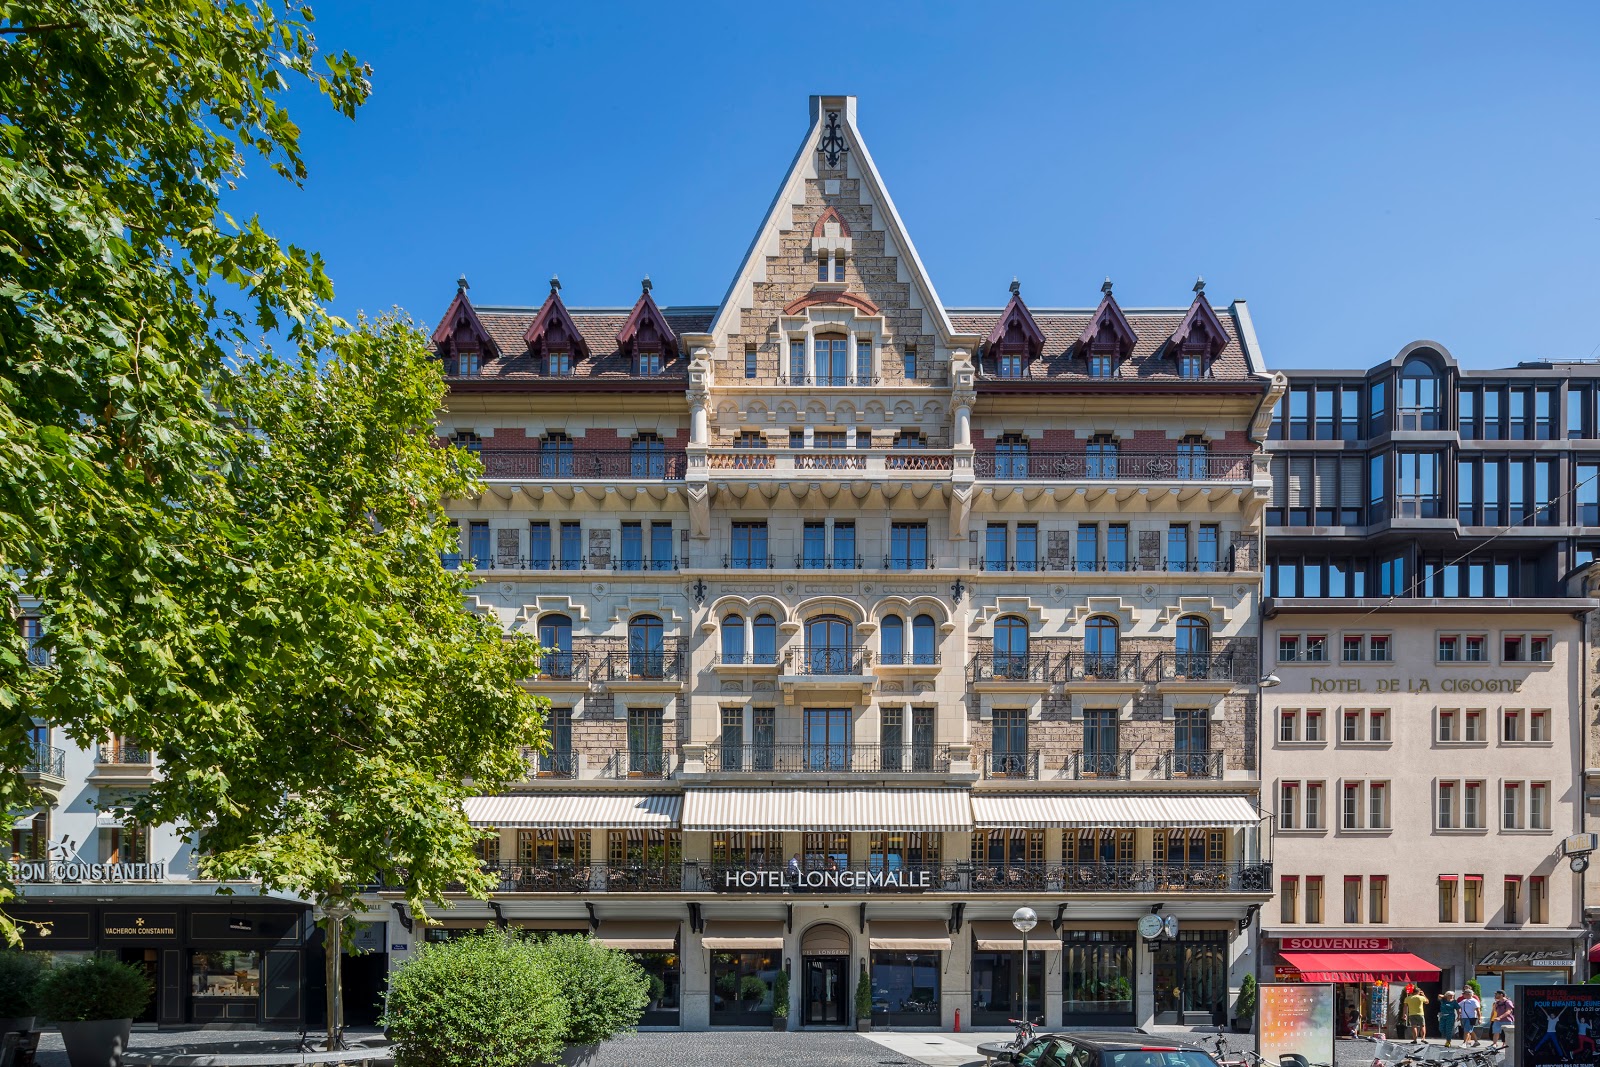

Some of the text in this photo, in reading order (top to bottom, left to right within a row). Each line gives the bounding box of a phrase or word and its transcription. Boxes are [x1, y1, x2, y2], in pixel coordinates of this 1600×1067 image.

[1374, 678, 1400, 694] DE
[1407, 678, 1431, 695] LA
[1441, 678, 1523, 694] CIGOGNE
[55, 862, 165, 880] CONSTANTIN
[726, 871, 930, 887] HOTEL LONGEMALLE
[1291, 938, 1380, 949] SOUVENIRS
